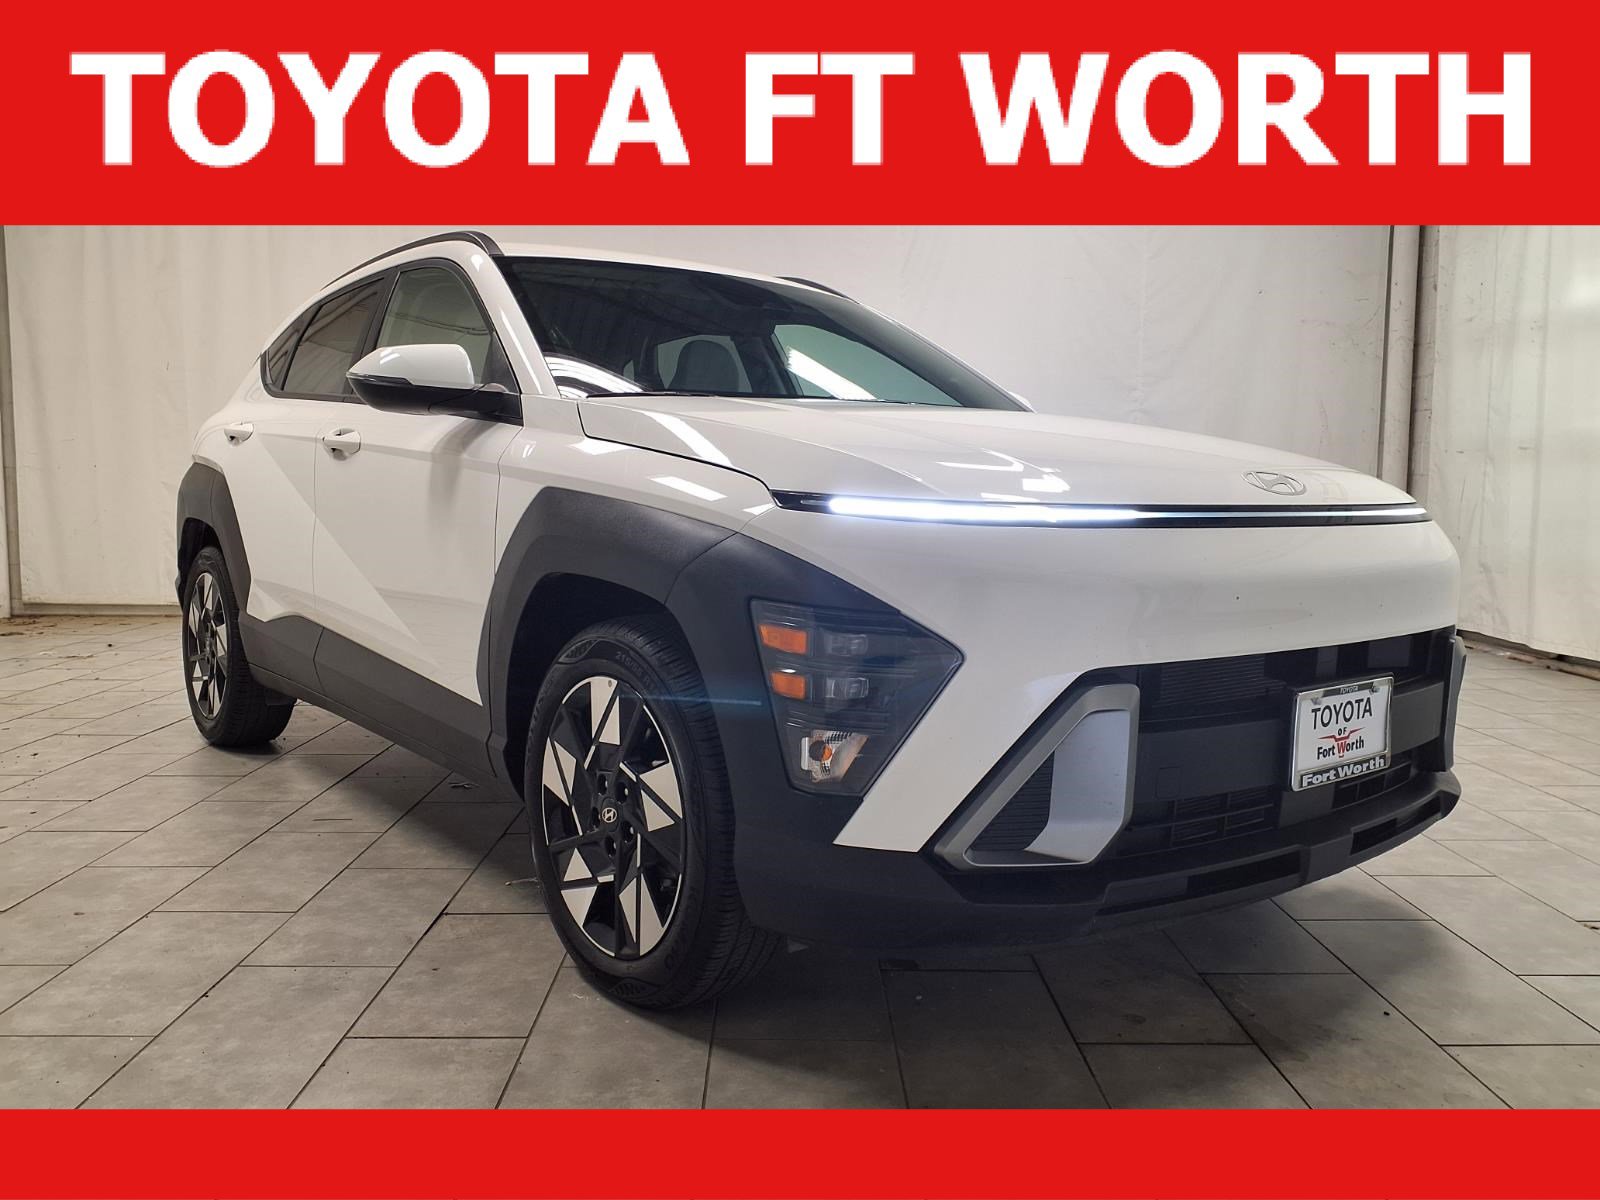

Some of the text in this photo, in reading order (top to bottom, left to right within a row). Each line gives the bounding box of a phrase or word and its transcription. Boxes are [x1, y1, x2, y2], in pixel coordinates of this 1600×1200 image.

[1311, 697, 1373, 730] TOYOTA
[1338, 727, 1347, 736] OF
[1317, 736, 1365, 760] Fort Worth
[1302, 757, 1385, 787] Fort Worth
